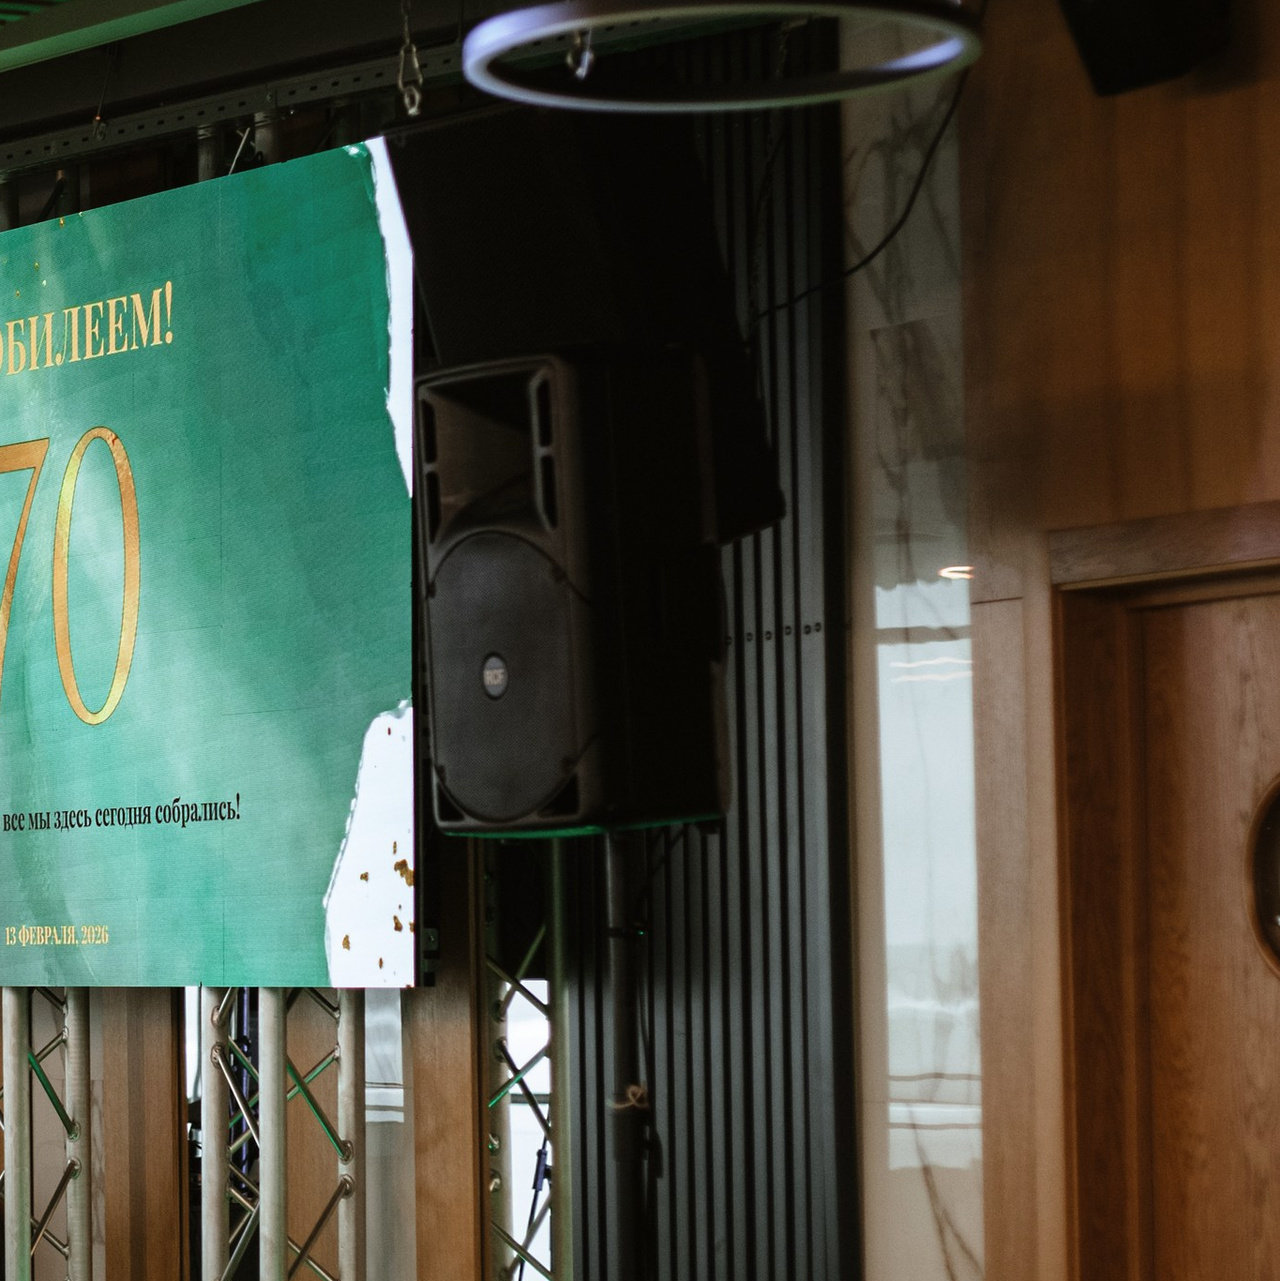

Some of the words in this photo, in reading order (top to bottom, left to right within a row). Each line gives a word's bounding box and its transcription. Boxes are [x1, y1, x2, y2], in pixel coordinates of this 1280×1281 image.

[483, 668, 505, 686] RCF
[3, 812, 25, 831] все
[28, 811, 51, 830] мы
[54, 809, 92, 832] здесь
[95, 805, 152, 829] сегодня
[155, 792, 241, 828] собрались!
[5, 926, 17, 945] 13
[81, 925, 109, 944] 2026
